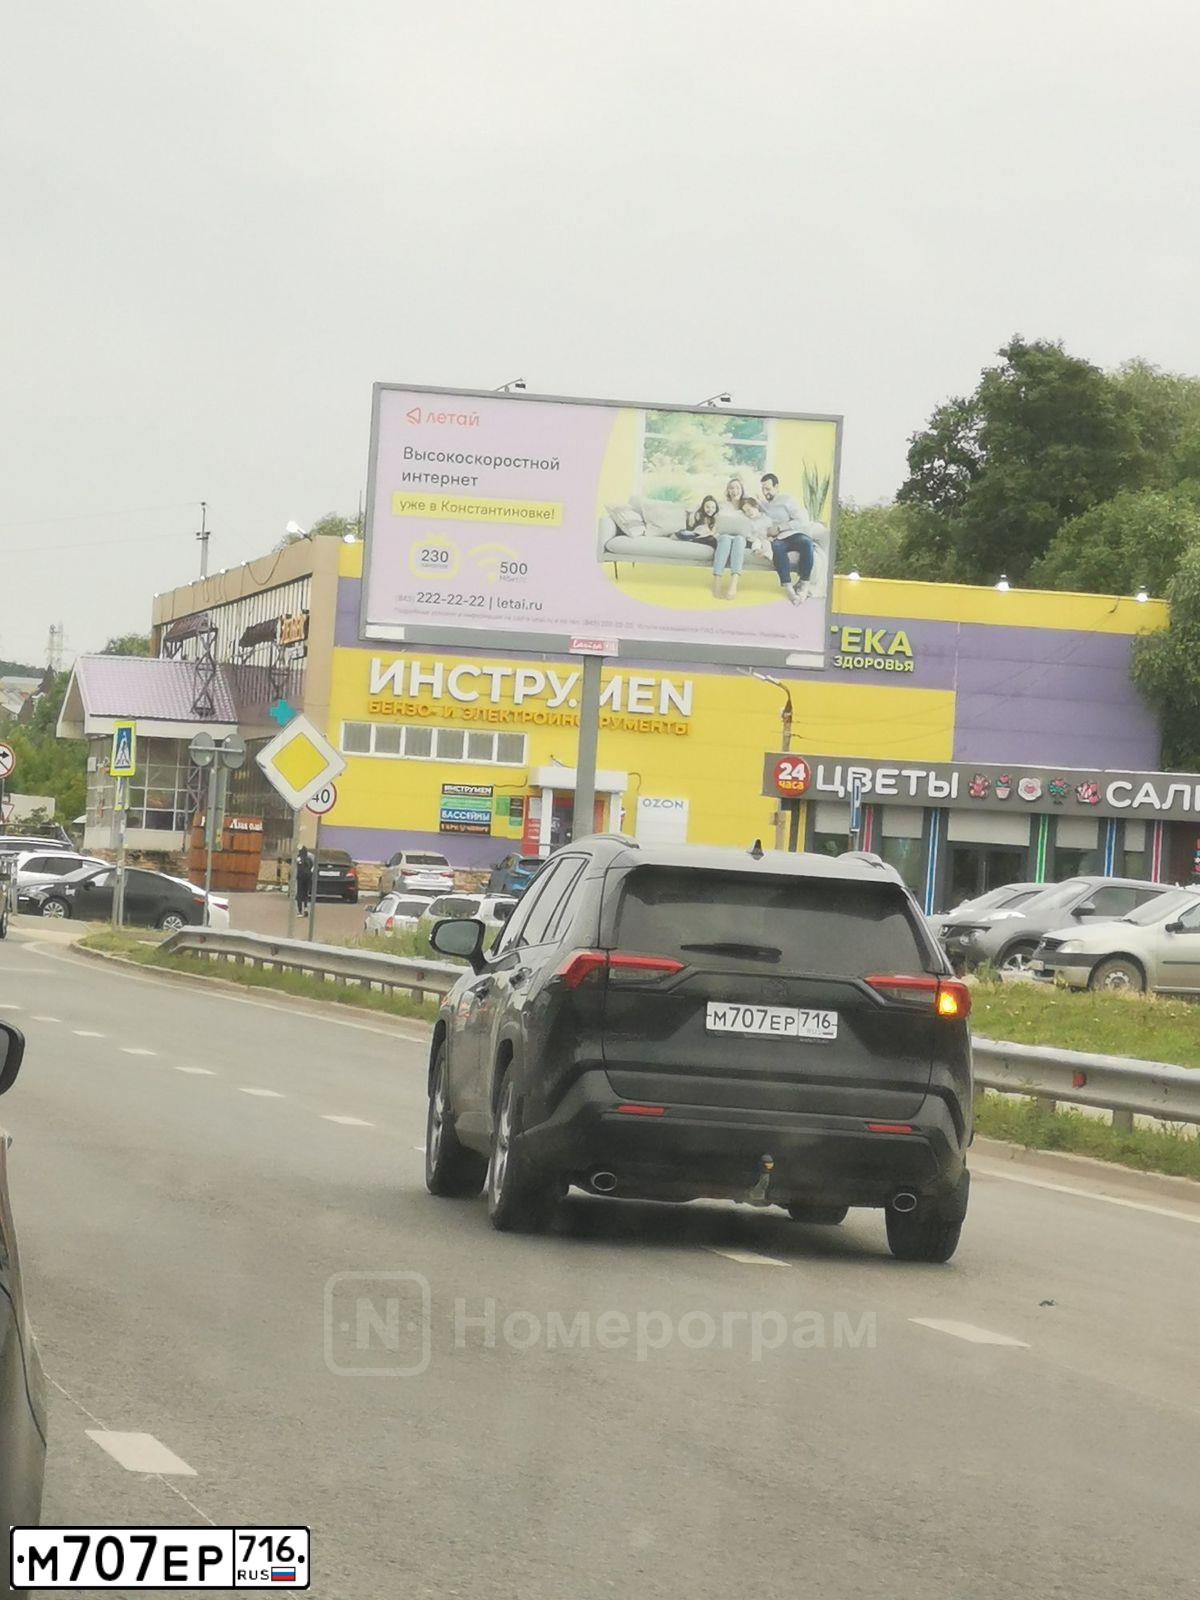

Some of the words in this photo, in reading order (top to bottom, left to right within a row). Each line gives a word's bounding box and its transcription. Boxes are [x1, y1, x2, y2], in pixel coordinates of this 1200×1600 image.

[426, 411, 480, 427] летай
[403, 446, 560, 471] Высокоскоростной
[402, 471, 478, 487] интернет
[400, 500, 426, 512] уже
[429, 502, 438, 512] в
[440, 500, 556, 520] Константиновке!
[421, 549, 449, 563] 230
[500, 561, 528, 576] 500
[416, 592, 485, 608] 222-22-22
[497, 597, 543, 611] letai.ru
[830, 625, 914, 657] ЕКА
[833, 655, 915, 672] ЗДОРОВЬЯ
[367, 700, 436, 718] БЕНЗО-
[443, 706, 454, 719] И
[778, 762, 806, 780] 24
[779, 779, 804, 791] часа
[816, 764, 959, 799] ЦВЕТЫ
[642, 798, 684, 808] OZON
[1105, 781, 1200, 811] САЛ
[713, 1006, 796, 1031] М707ЕР
[801, 1011, 831, 1029] 716
